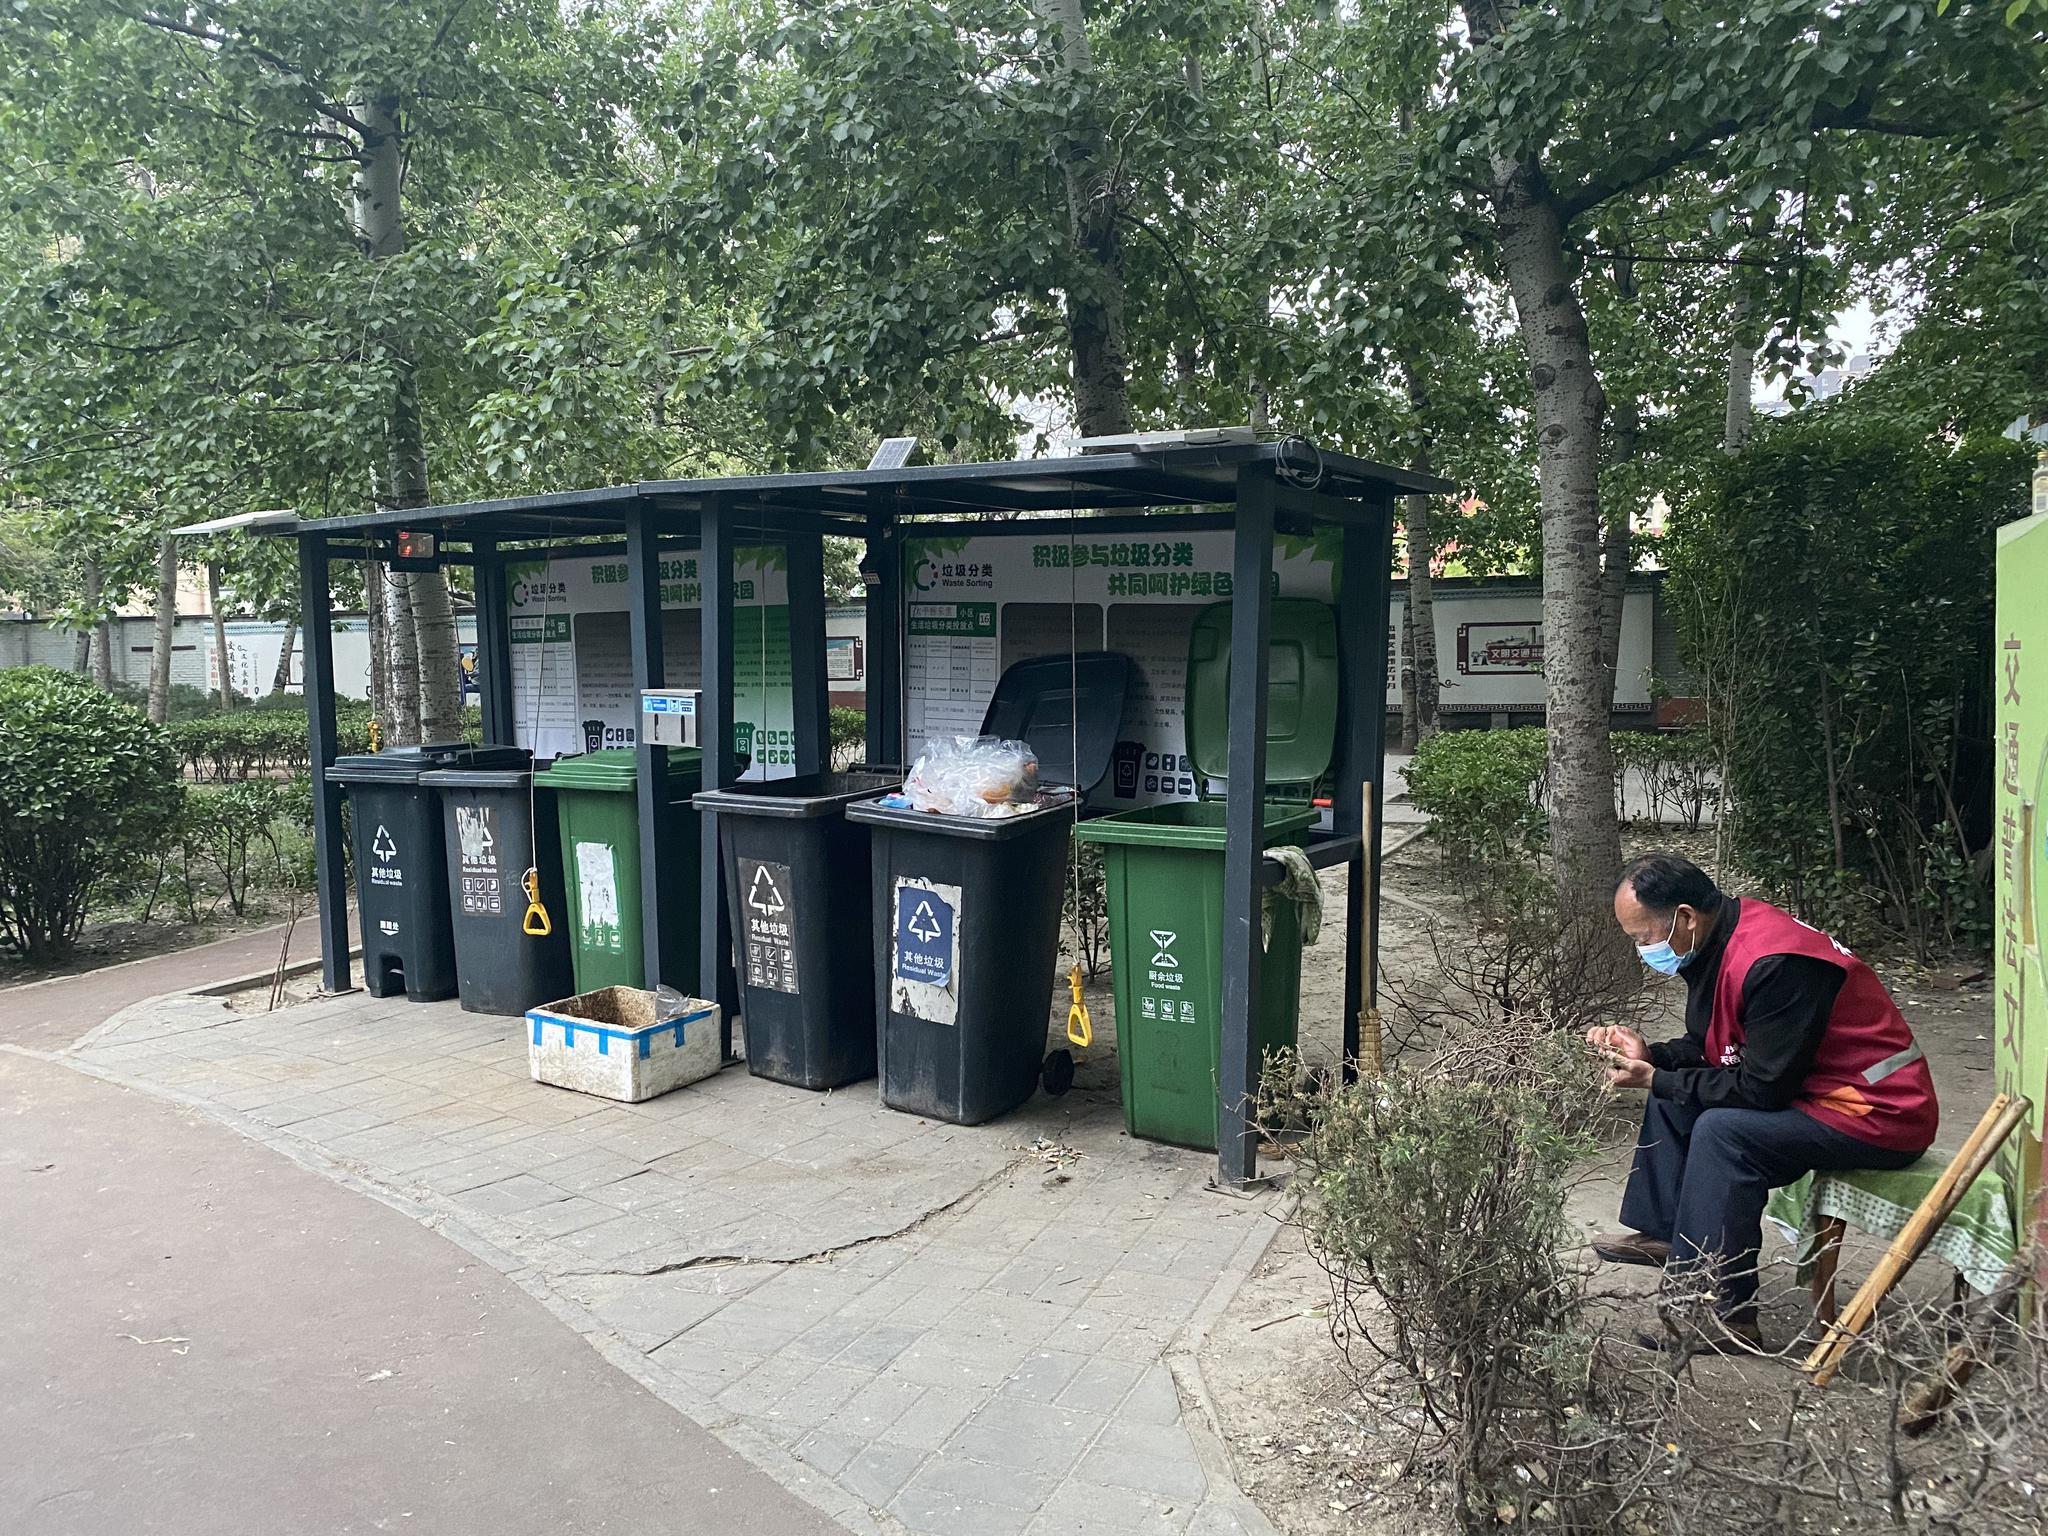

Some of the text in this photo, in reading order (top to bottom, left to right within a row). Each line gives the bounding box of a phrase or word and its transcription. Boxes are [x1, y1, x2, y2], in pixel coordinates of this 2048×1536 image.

[1033, 542, 1194, 568] 积极参与垃圾分类
[942, 563, 993, 578] 垃圾分类
[942, 579, 993, 589] Waste Sorting
[960, 607, 975, 618] 小区
[980, 613, 990, 624] 16
[1491, 648, 1531, 659] 文明交通
[462, 855, 496, 865] 其他垃圾
[371, 867, 402, 879] 其他垃圾
[751, 918, 789, 937] 其他垃圾
[751, 933, 789, 946] Residual Waste
[904, 951, 944, 969] 其他垃圾
[901, 962, 927, 975] Residual
[1148, 970, 1183, 983] 厨余垃圾
[1151, 981, 1164, 989] Food
